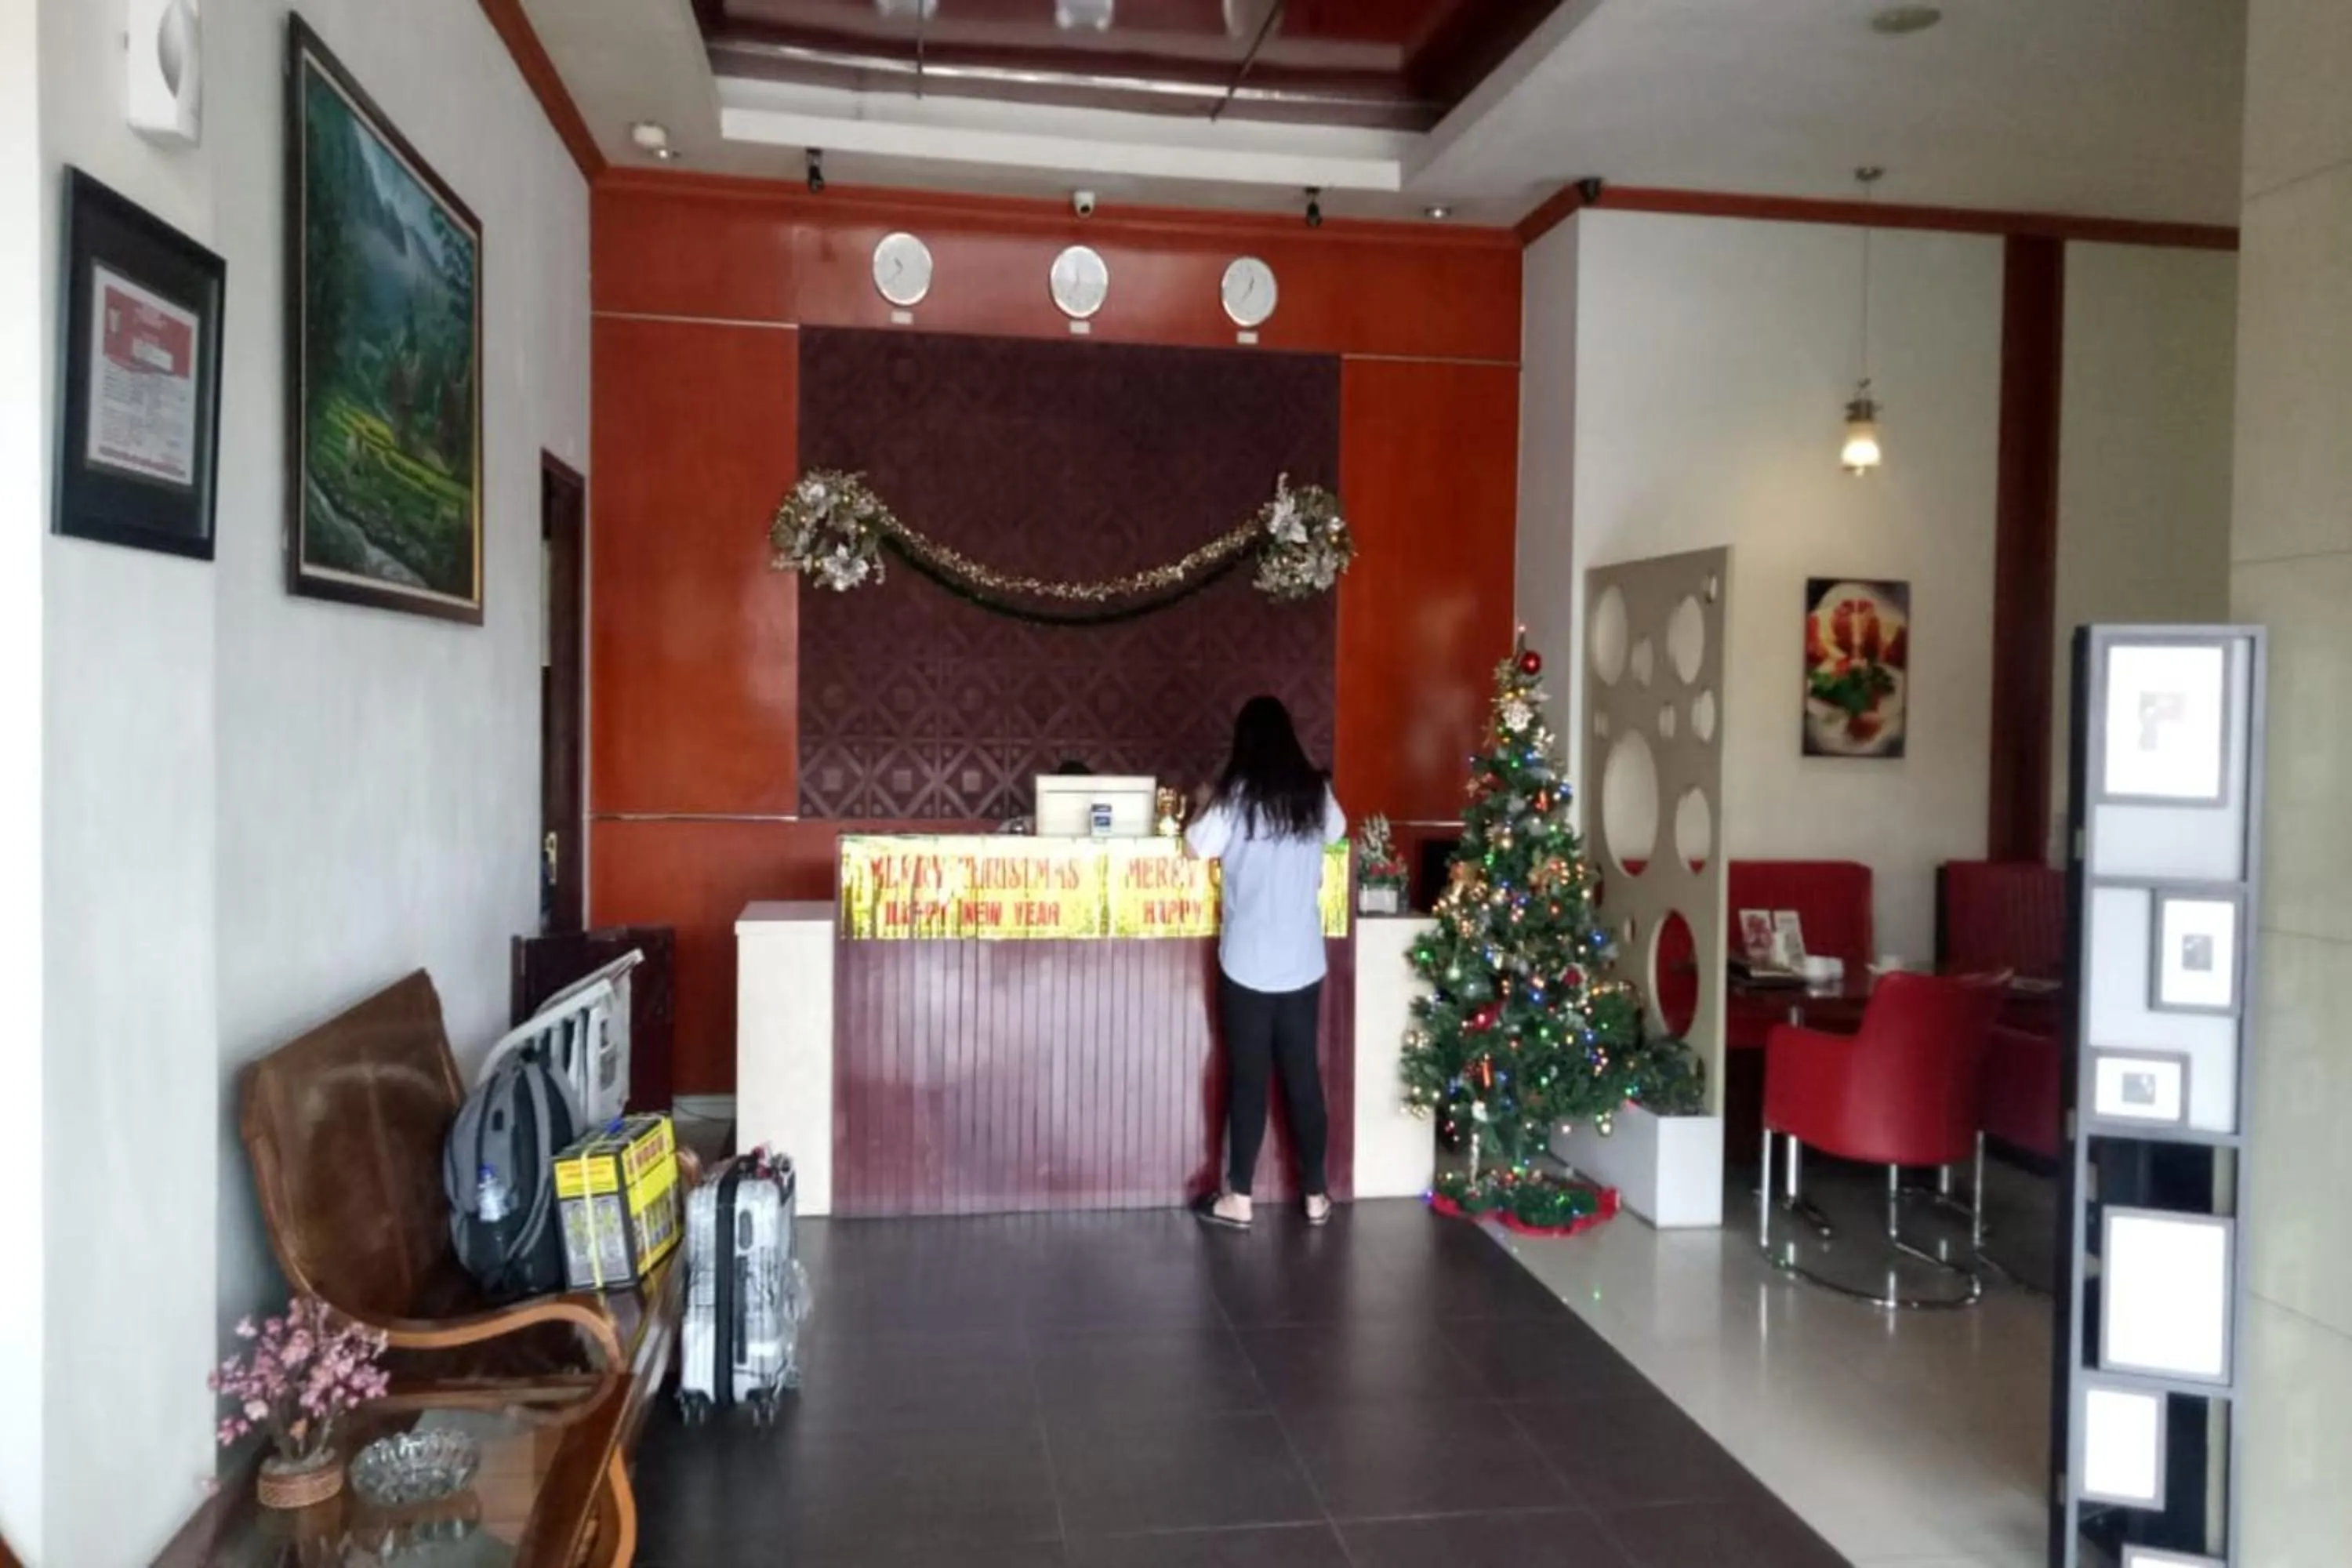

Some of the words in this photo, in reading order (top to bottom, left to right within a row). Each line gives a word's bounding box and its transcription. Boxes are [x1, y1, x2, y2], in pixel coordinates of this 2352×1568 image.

[961, 900, 1002, 926] NEW
[1014, 900, 1060, 926] YEAR
[1143, 899, 1201, 925] HAPPY
